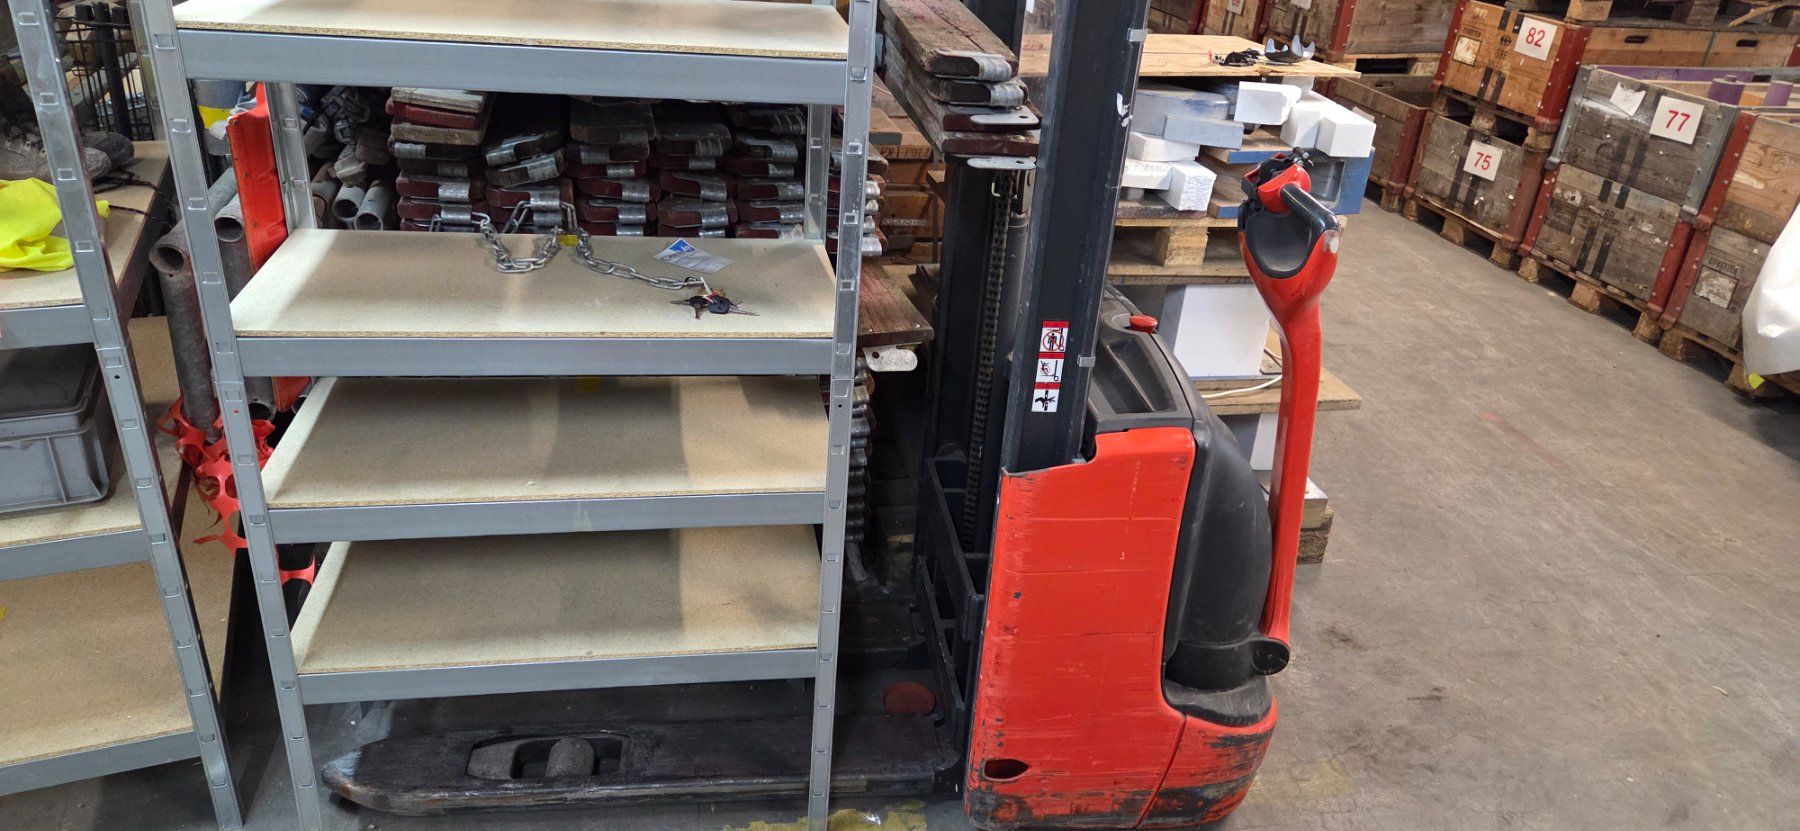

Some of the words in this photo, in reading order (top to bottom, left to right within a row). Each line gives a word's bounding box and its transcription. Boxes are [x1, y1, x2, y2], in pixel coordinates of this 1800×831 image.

[1526, 27, 1547, 48] 82
[1666, 109, 1691, 132] 77
[1474, 151, 1492, 171] 75
